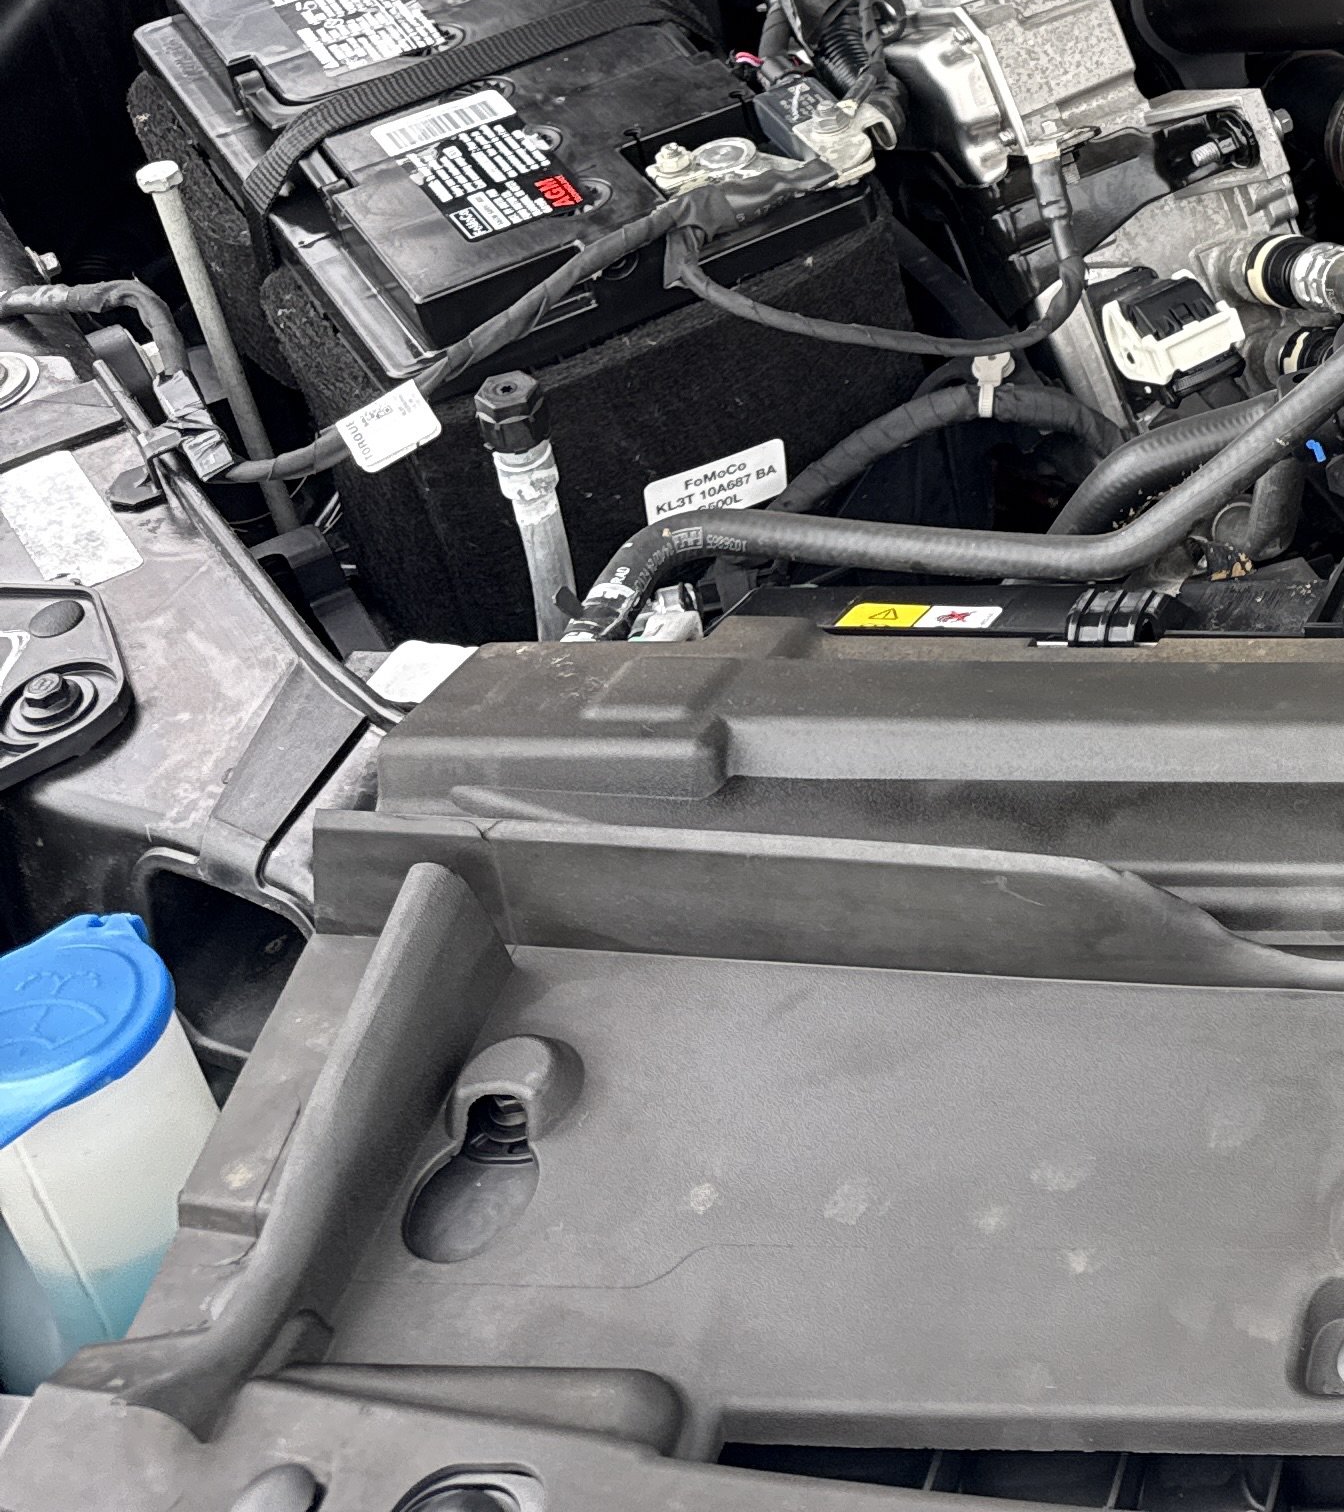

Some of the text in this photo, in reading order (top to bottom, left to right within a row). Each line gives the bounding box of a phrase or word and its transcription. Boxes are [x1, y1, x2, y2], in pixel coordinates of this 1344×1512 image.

[534, 177, 577, 208] AGM
[656, 464, 777, 514] KL3T 10A687 BA
[684, 461, 747, 490] FoMoCo
